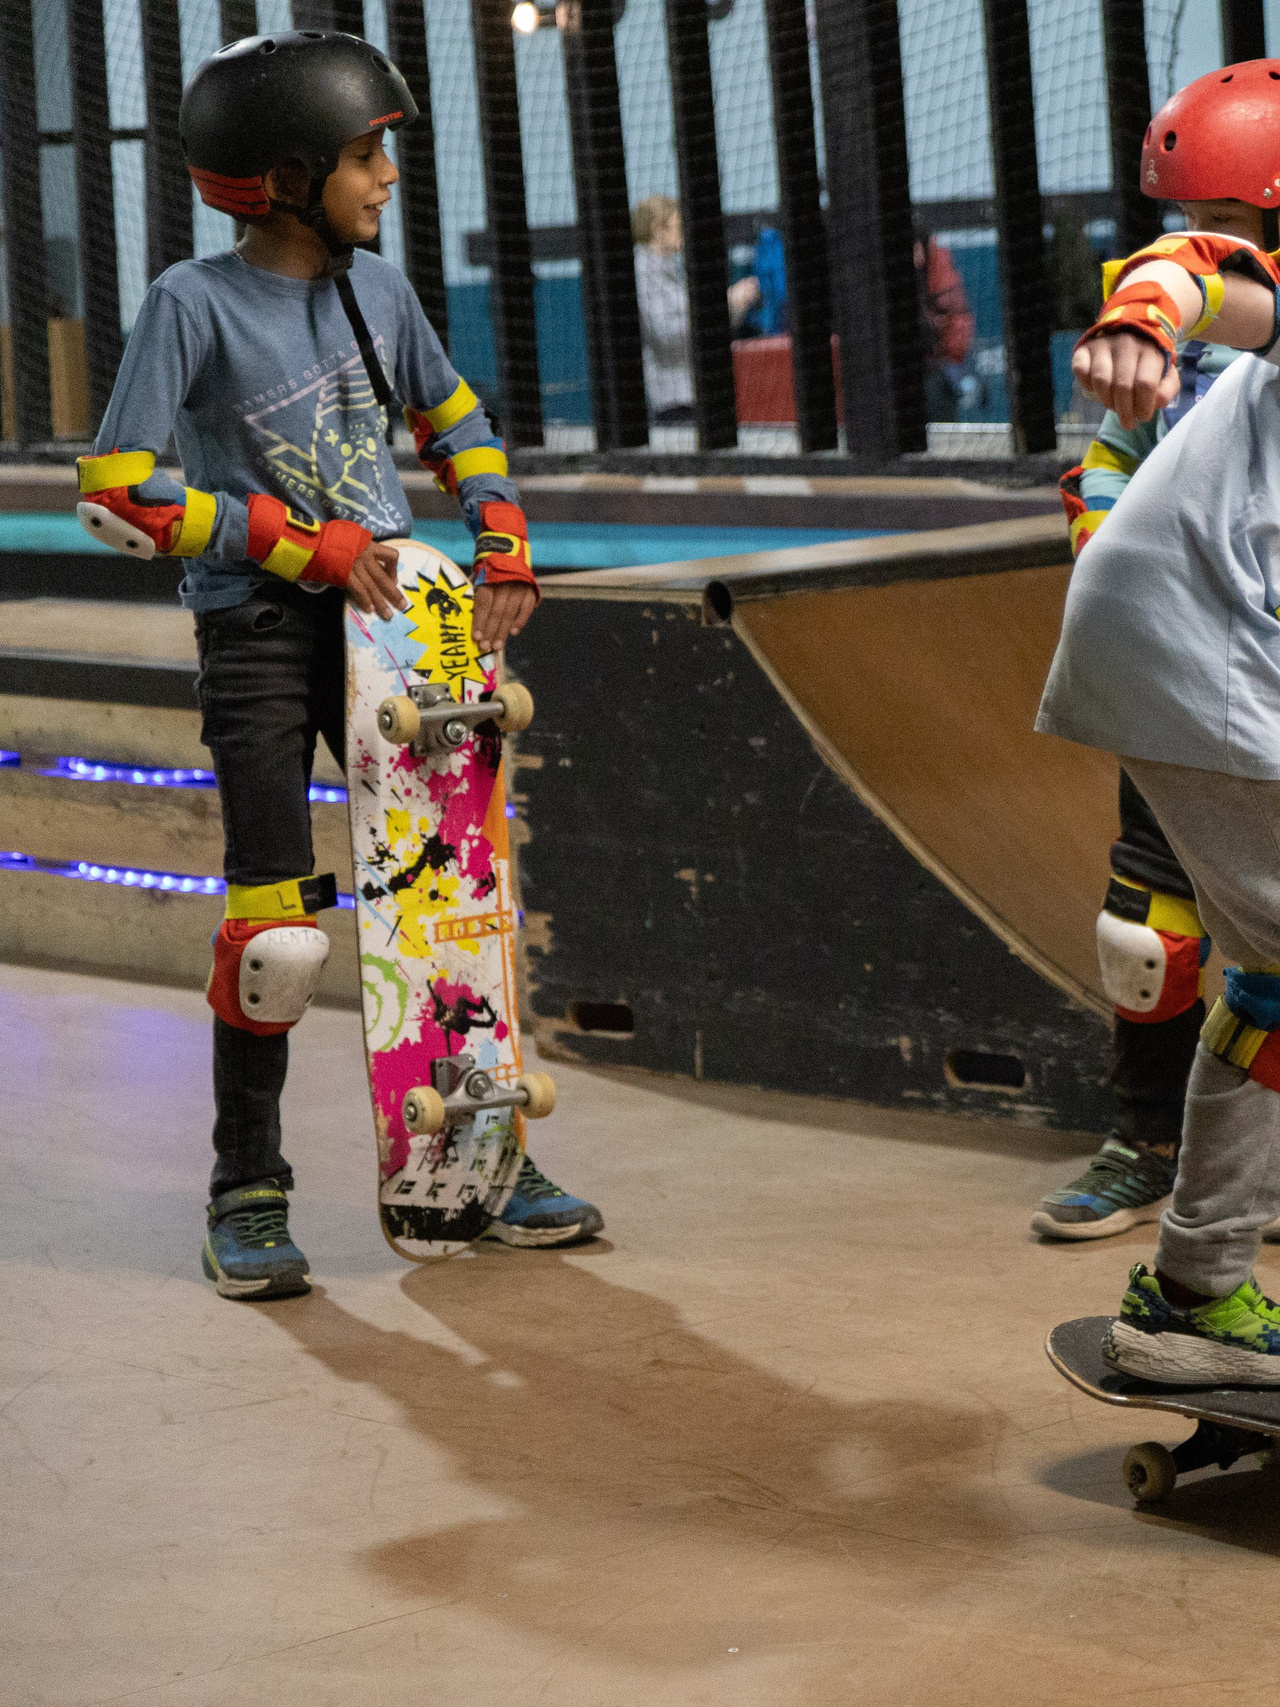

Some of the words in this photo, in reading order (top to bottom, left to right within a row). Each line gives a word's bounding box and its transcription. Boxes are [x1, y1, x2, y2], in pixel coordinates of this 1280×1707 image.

[303, 350, 346, 381] GOTTA
[440, 623, 470, 681] YEAH!
[277, 890, 297, 910] L
